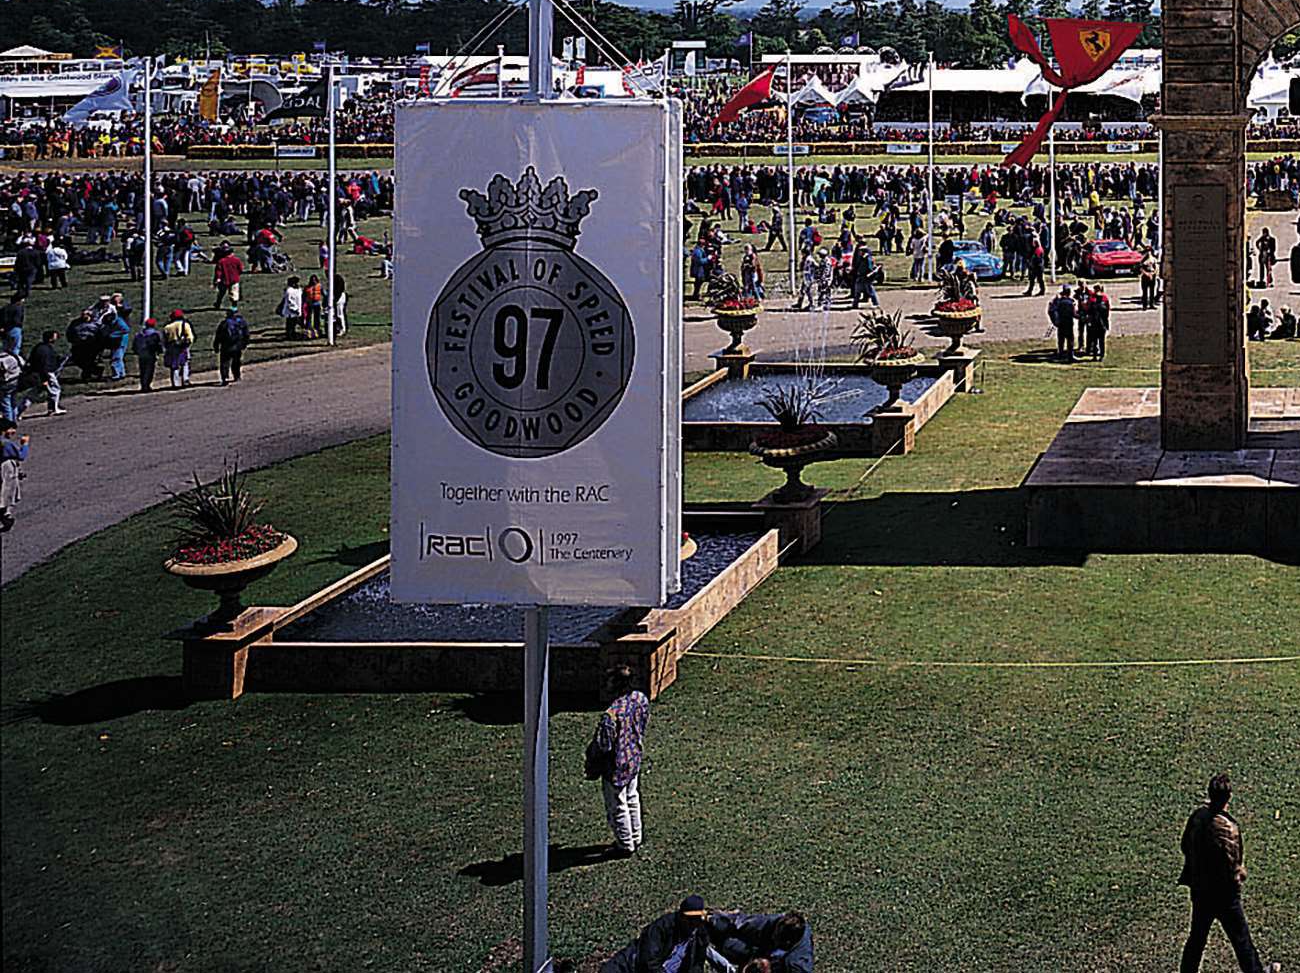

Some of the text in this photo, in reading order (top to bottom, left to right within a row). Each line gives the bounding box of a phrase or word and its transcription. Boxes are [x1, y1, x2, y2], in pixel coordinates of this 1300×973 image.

[444, 257, 615, 356] FESTIVAL OF SPEED
[492, 304, 564, 390] 97
[454, 382, 599, 441] GOODWOOD
[440, 481, 609, 504] Together with the RAC
[549, 532, 578, 545] 1997
[549, 547, 632, 563] The Centenary
